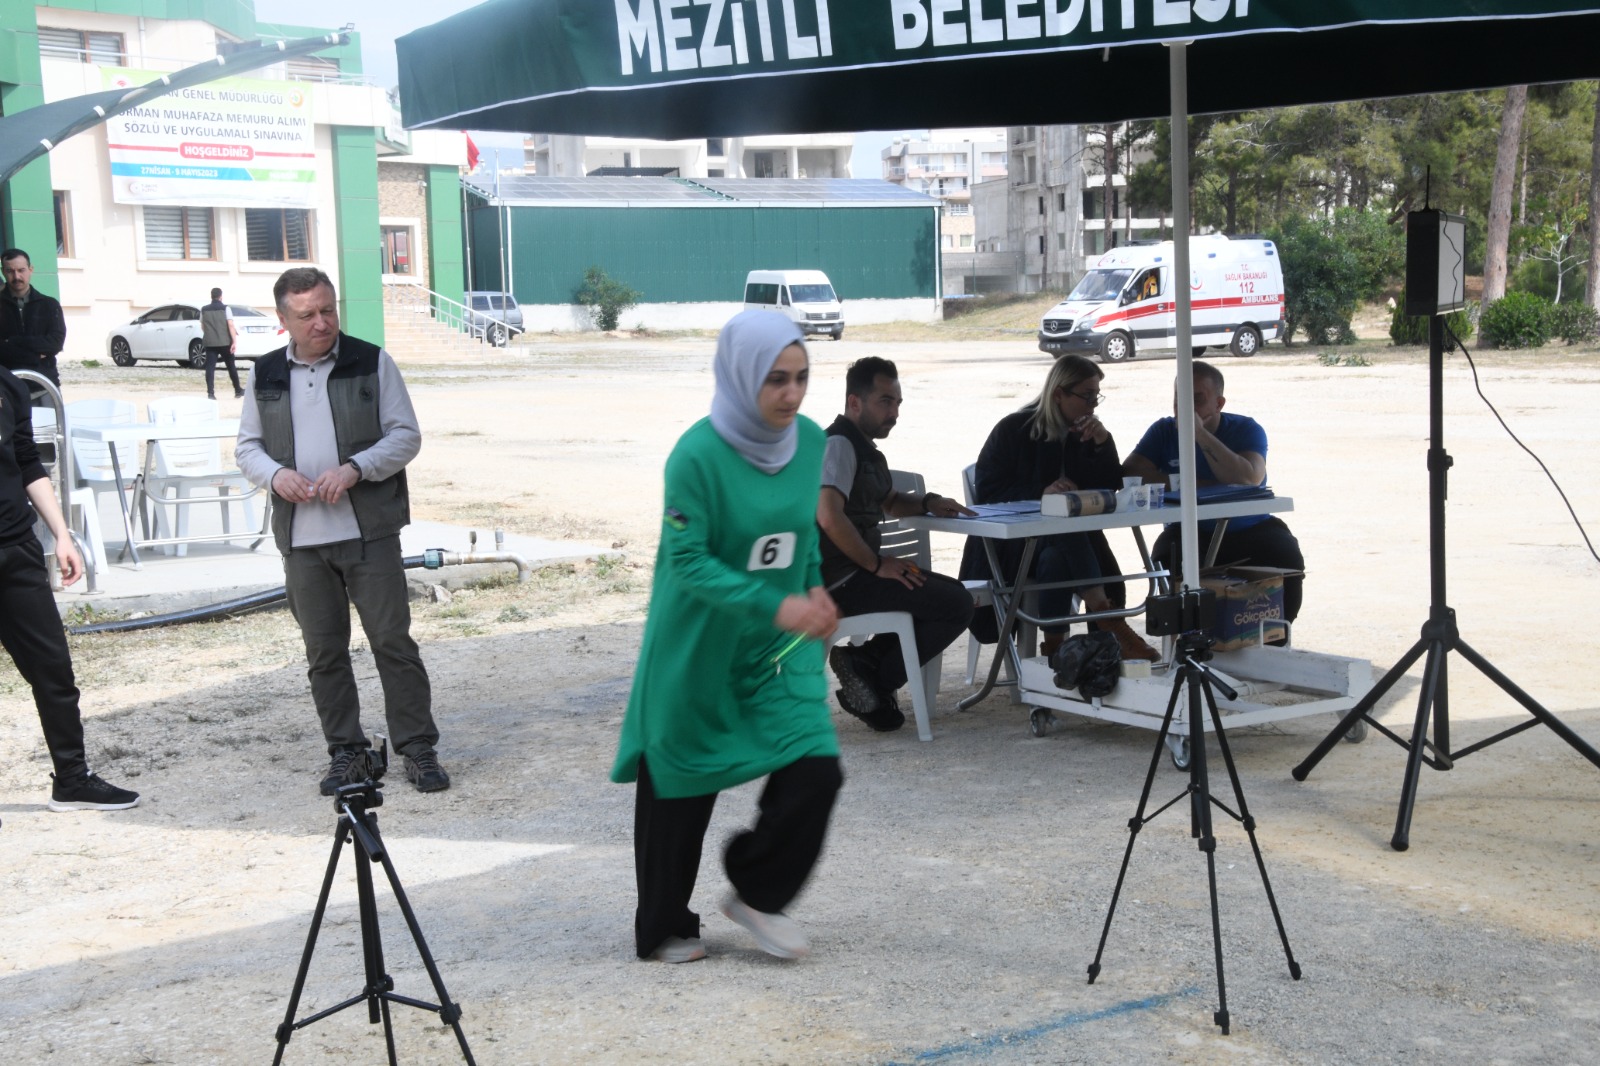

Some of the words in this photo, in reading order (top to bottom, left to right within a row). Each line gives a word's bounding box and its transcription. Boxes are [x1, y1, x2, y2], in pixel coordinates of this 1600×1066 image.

[890, 0, 1250, 50] BELED
[182, 88, 216, 101] GENEL
[163, 109, 224, 122] MUHAFAZA
[226, 113, 274, 125] MEMURU
[277, 116, 306, 127] ALIMI
[124, 120, 160, 134] SÖZLÜ
[163, 124, 178, 135] VE
[181, 125, 250, 139] UYGULAMALI
[253, 129, 303, 142] SINAVINA
[184, 144, 249, 158] HOŞGELDİNİZ
[1240, 281, 1254, 293] 112
[1241, 294, 1279, 304] AMBULANS
[760, 538, 780, 565] 6
[1234, 605, 1281, 625] Gökçedağ
